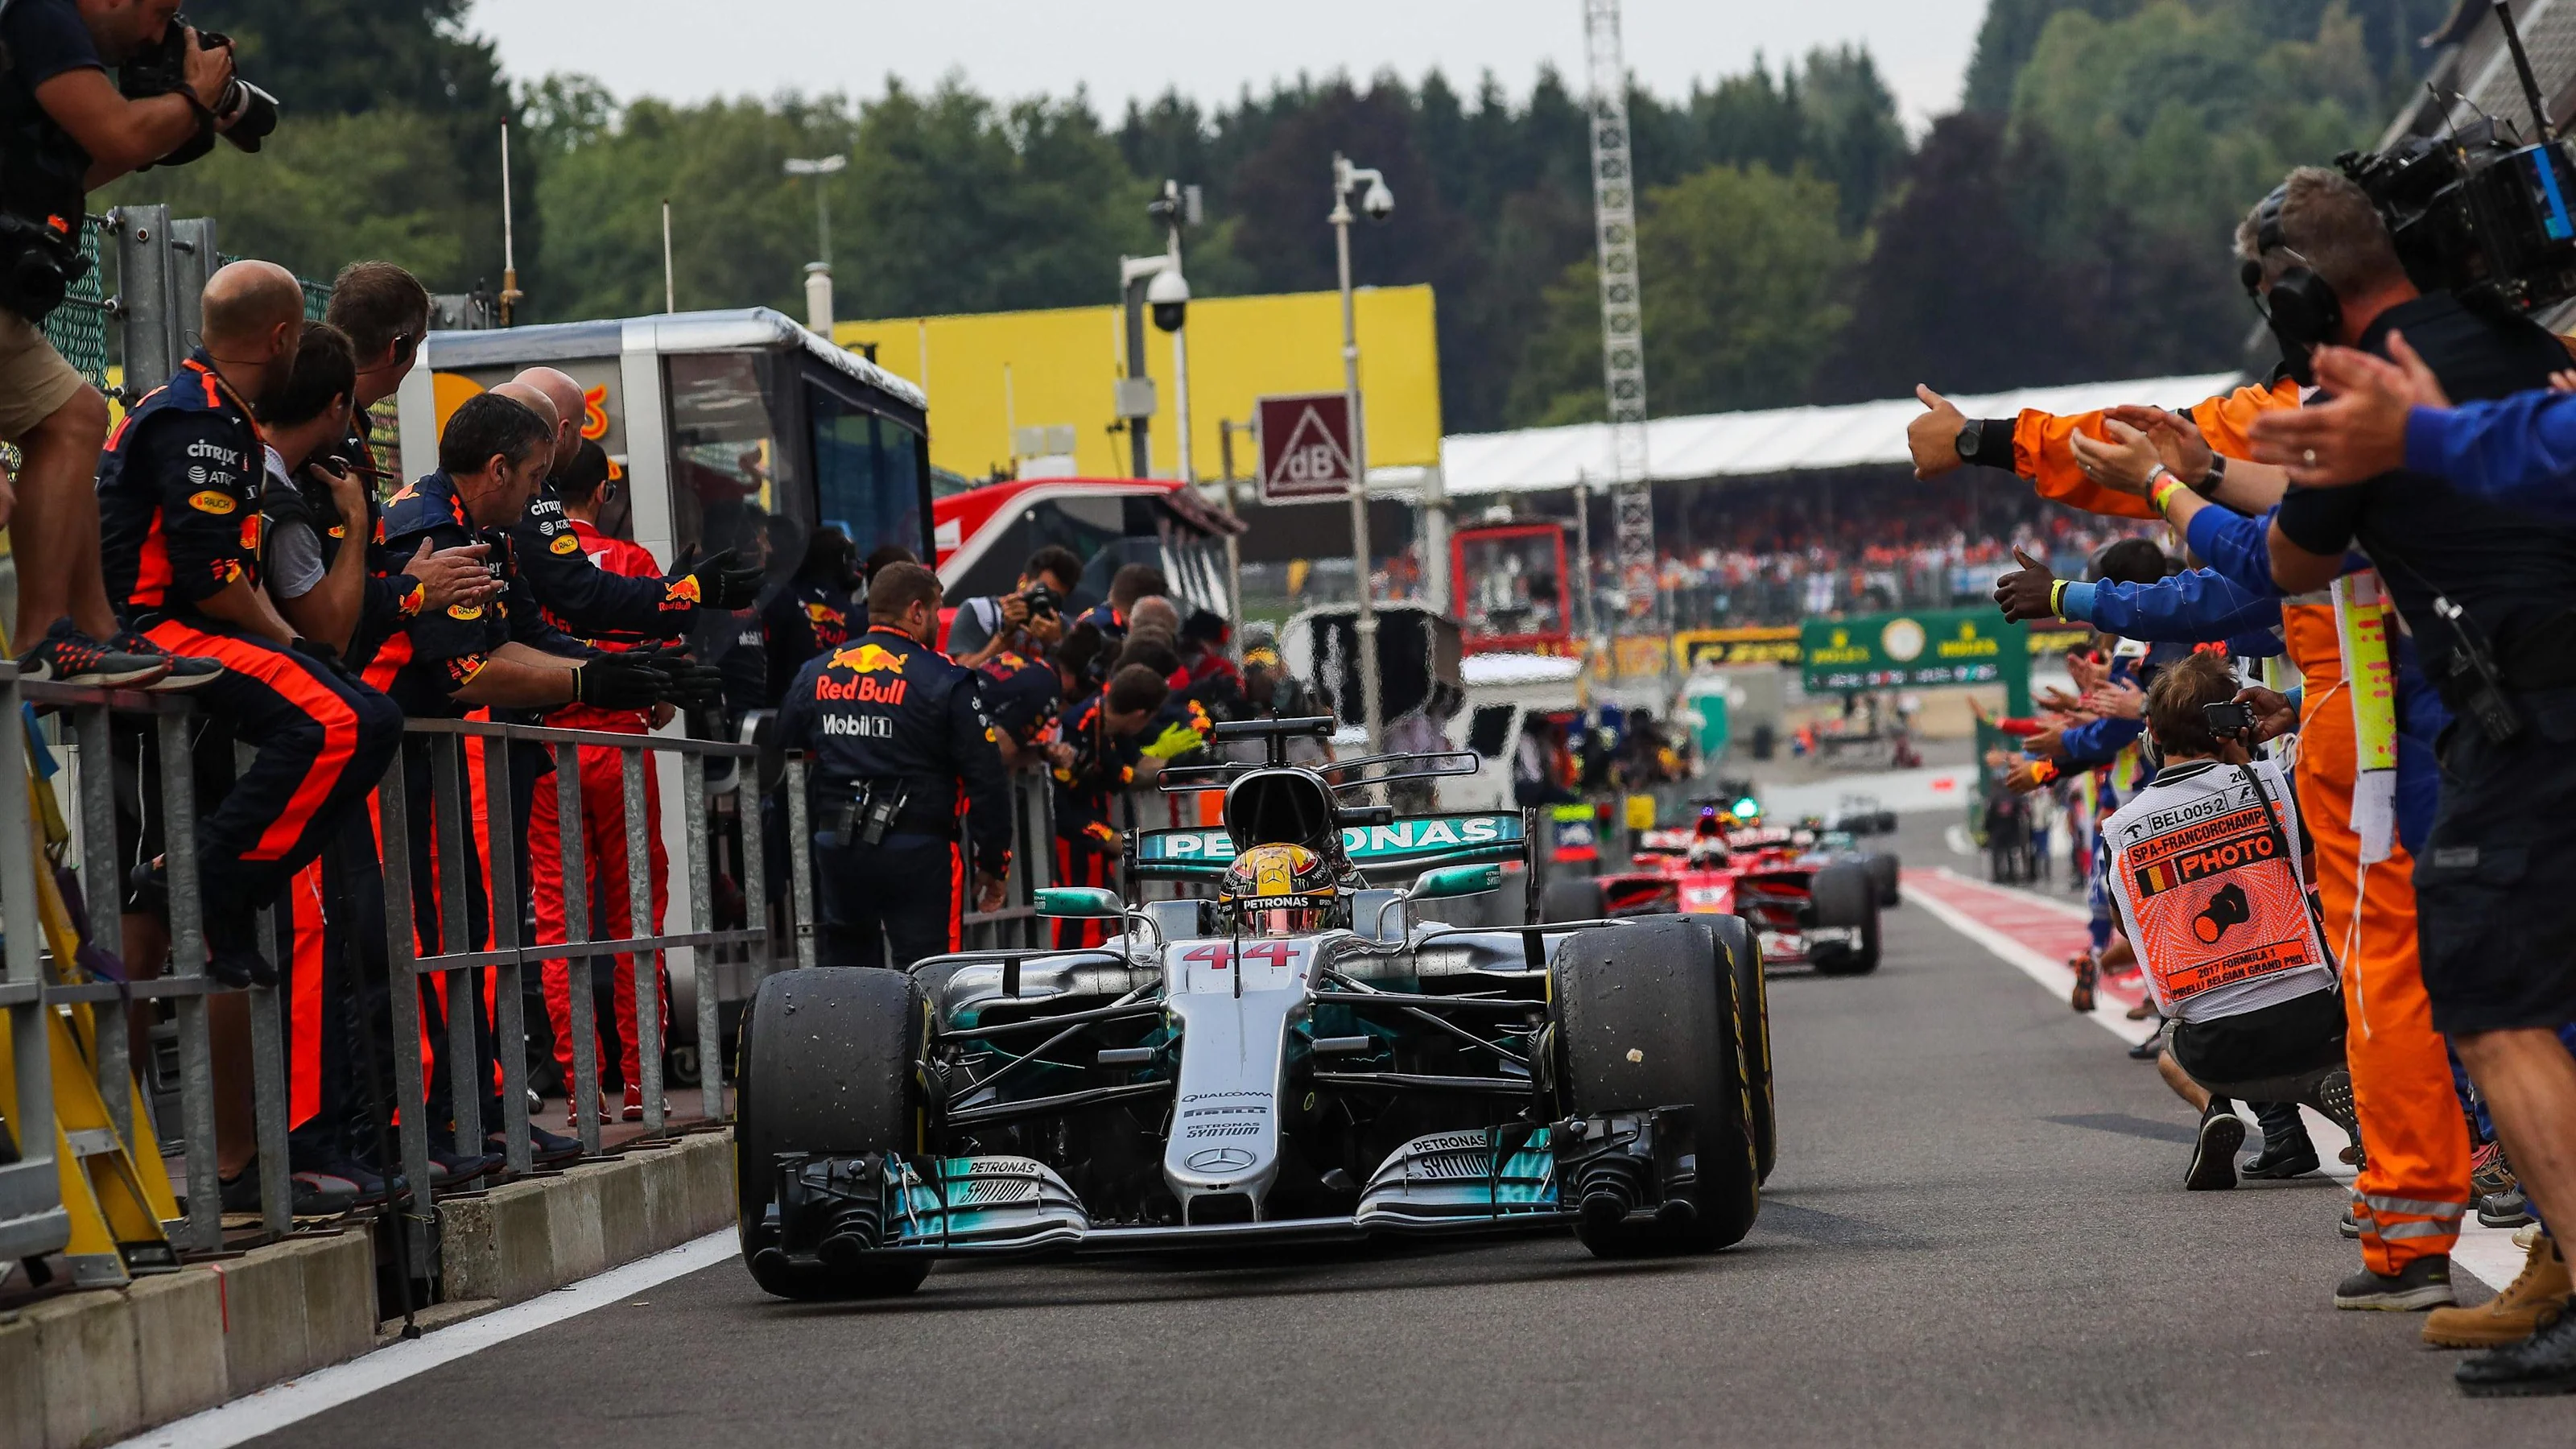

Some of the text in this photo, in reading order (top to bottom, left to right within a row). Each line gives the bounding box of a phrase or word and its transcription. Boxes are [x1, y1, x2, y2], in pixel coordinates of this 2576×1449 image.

[187, 439, 239, 466] CITRIX
[1289, 444, 1335, 480] dB
[204, 497, 230, 510] RAUCH
[530, 499, 562, 516] CITRIX
[558, 538, 575, 550] RAUCH
[658, 601, 691, 612] Red Bull
[816, 675, 907, 705] Red Bull
[823, 714, 869, 736] Mobil
[1165, 817, 1498, 858] PEONAS
[2181, 835, 2274, 878] PHOTO
[1243, 897, 1309, 910] PETRONAS
[1183, 940, 1300, 969] 44
[2198, 948, 2277, 979] 2017 FORMULA 1
[2173, 981, 2205, 999] PIRELLI
[2207, 969, 2246, 987] BELGIAN
[2248, 960, 2281, 975] GRAND
[2284, 954, 2306, 966] PRIX
[1181, 1092, 1274, 1103] QUALCOMM
[1183, 1105, 1268, 1118] PIRELLI
[1187, 1122, 1261, 1130] PETRONAS
[1187, 1127, 1261, 1138] SYNTIUM
[1412, 1135, 1486, 1153] PETRONAS
[968, 1162, 1037, 1174] PETRONAS
[1420, 1154, 1489, 1179] SYNTIUM
[959, 1180, 1032, 1203] SYNTIUM
